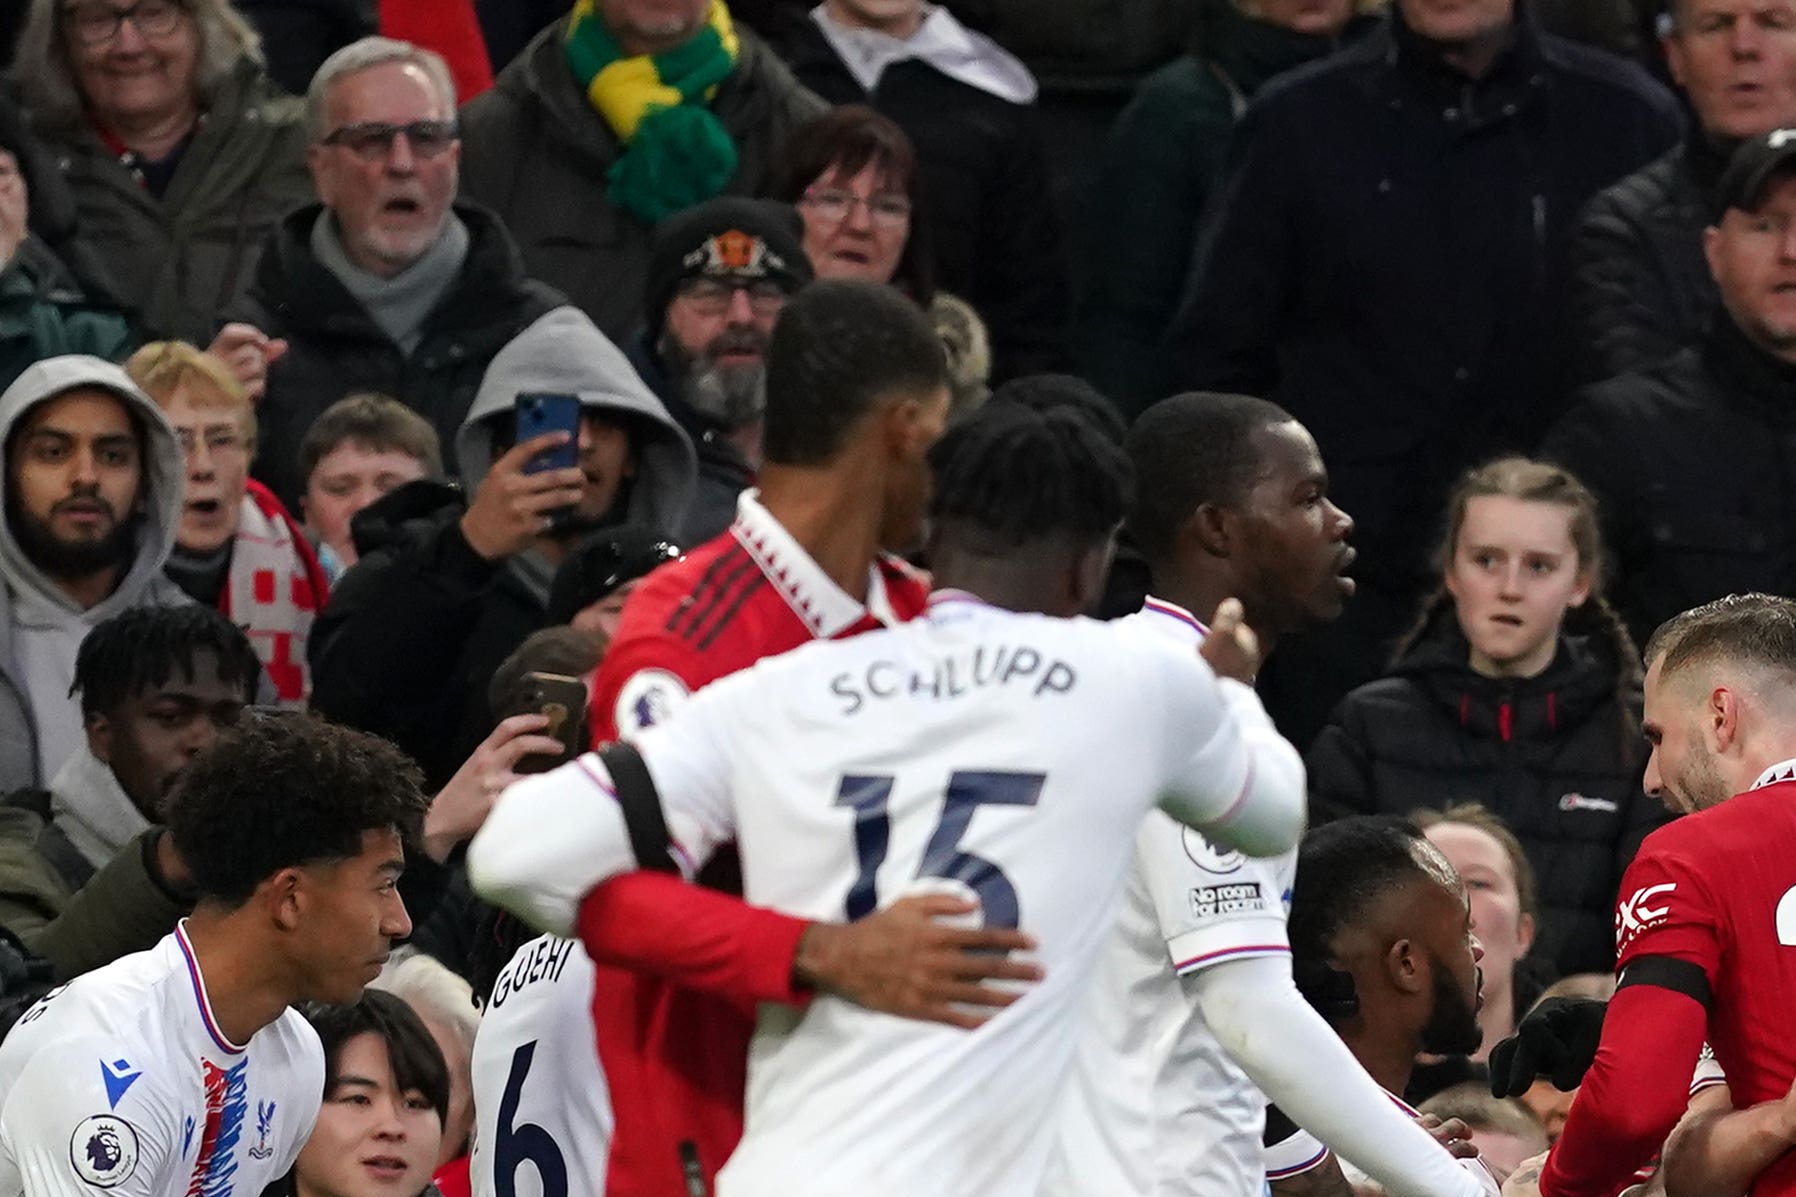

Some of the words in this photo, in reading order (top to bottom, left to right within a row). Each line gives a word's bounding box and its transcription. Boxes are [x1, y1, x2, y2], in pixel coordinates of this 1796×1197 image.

[829, 645, 1077, 715] SCHLUPP
[831, 769, 1048, 972] 15
[493, 936, 575, 1008] GUEHI
